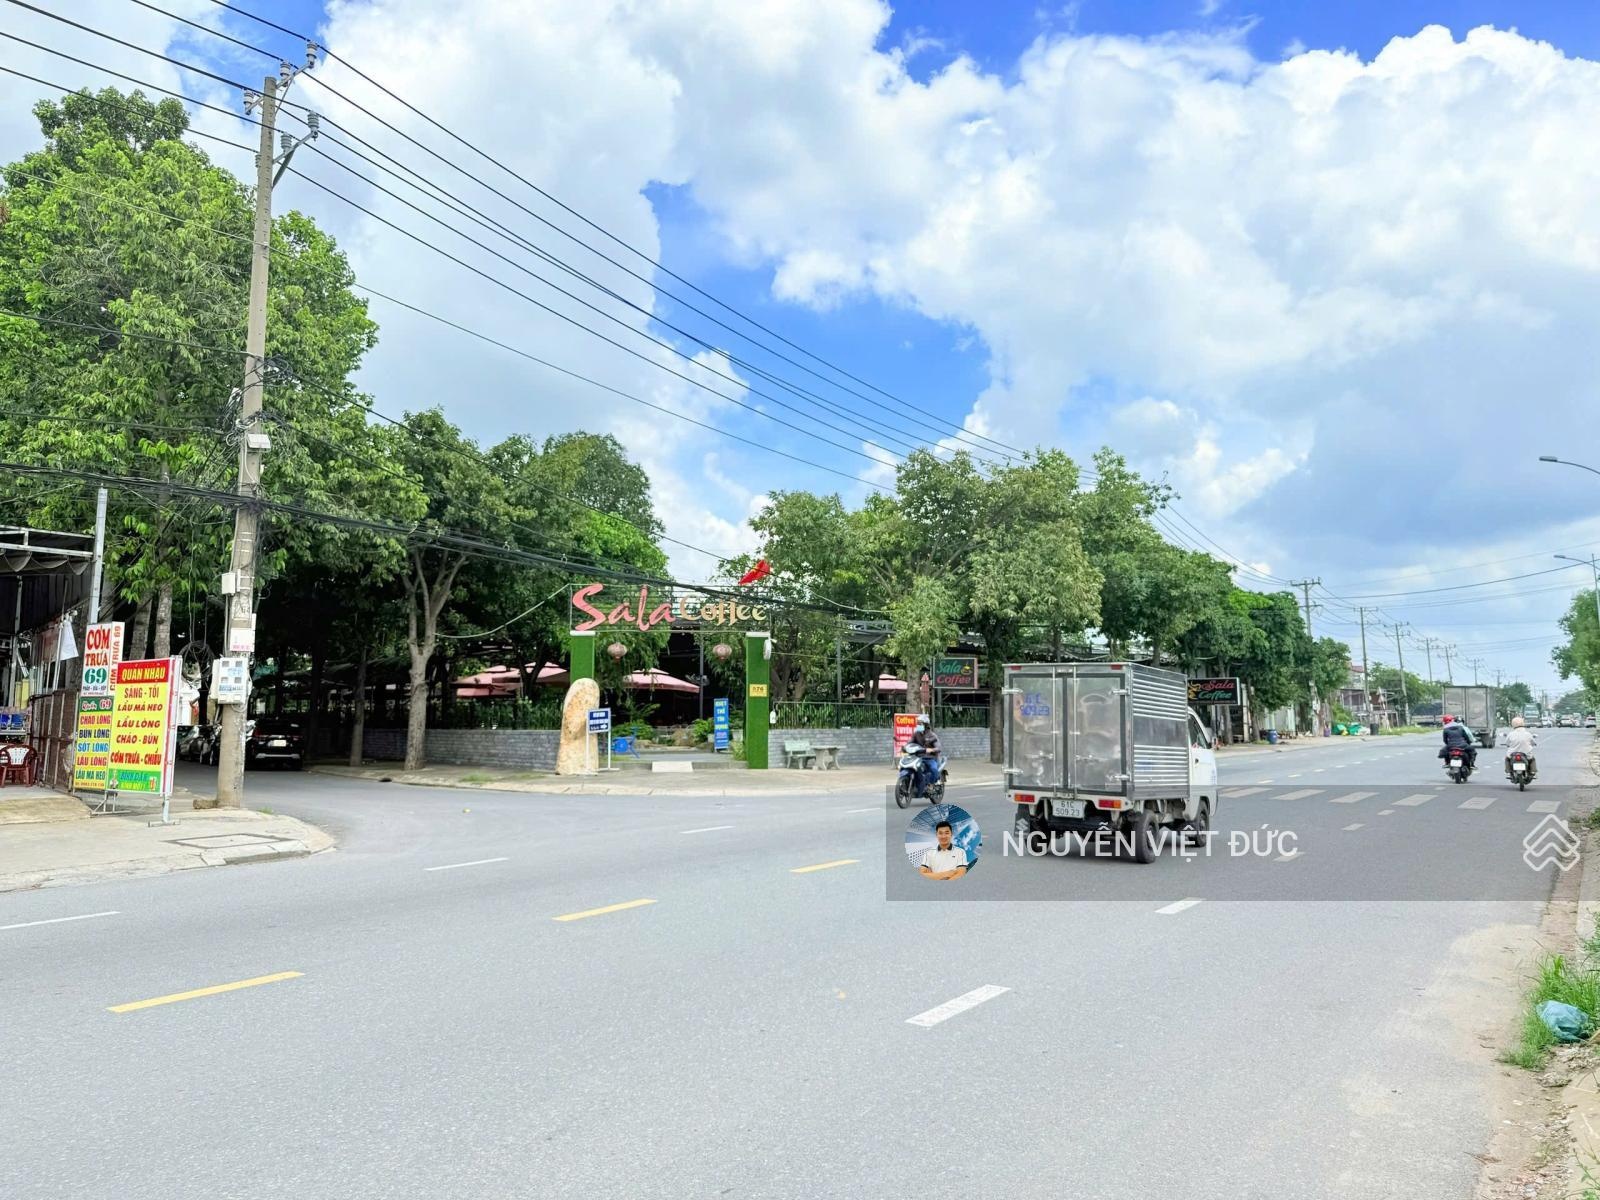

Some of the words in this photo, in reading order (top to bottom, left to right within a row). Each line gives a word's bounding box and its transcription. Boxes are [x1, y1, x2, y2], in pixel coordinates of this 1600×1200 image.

[572, 583, 675, 631] Sala
[679, 593, 767, 626] Coffee
[87, 625, 111, 650] CƠM
[114, 626, 121, 637] 69
[85, 650, 108, 666] TRƯA
[121, 664, 143, 681] QUÁN
[144, 663, 166, 682] NHẬU
[936, 660, 961, 674] Sala
[84, 668, 107, 684] 69
[936, 674, 971, 686] Coffee
[1201, 680, 1235, 691] Sala
[1199, 691, 1233, 700] Coffee
[100, 699, 112, 710] 69
[147, 703, 163, 711] HEO
